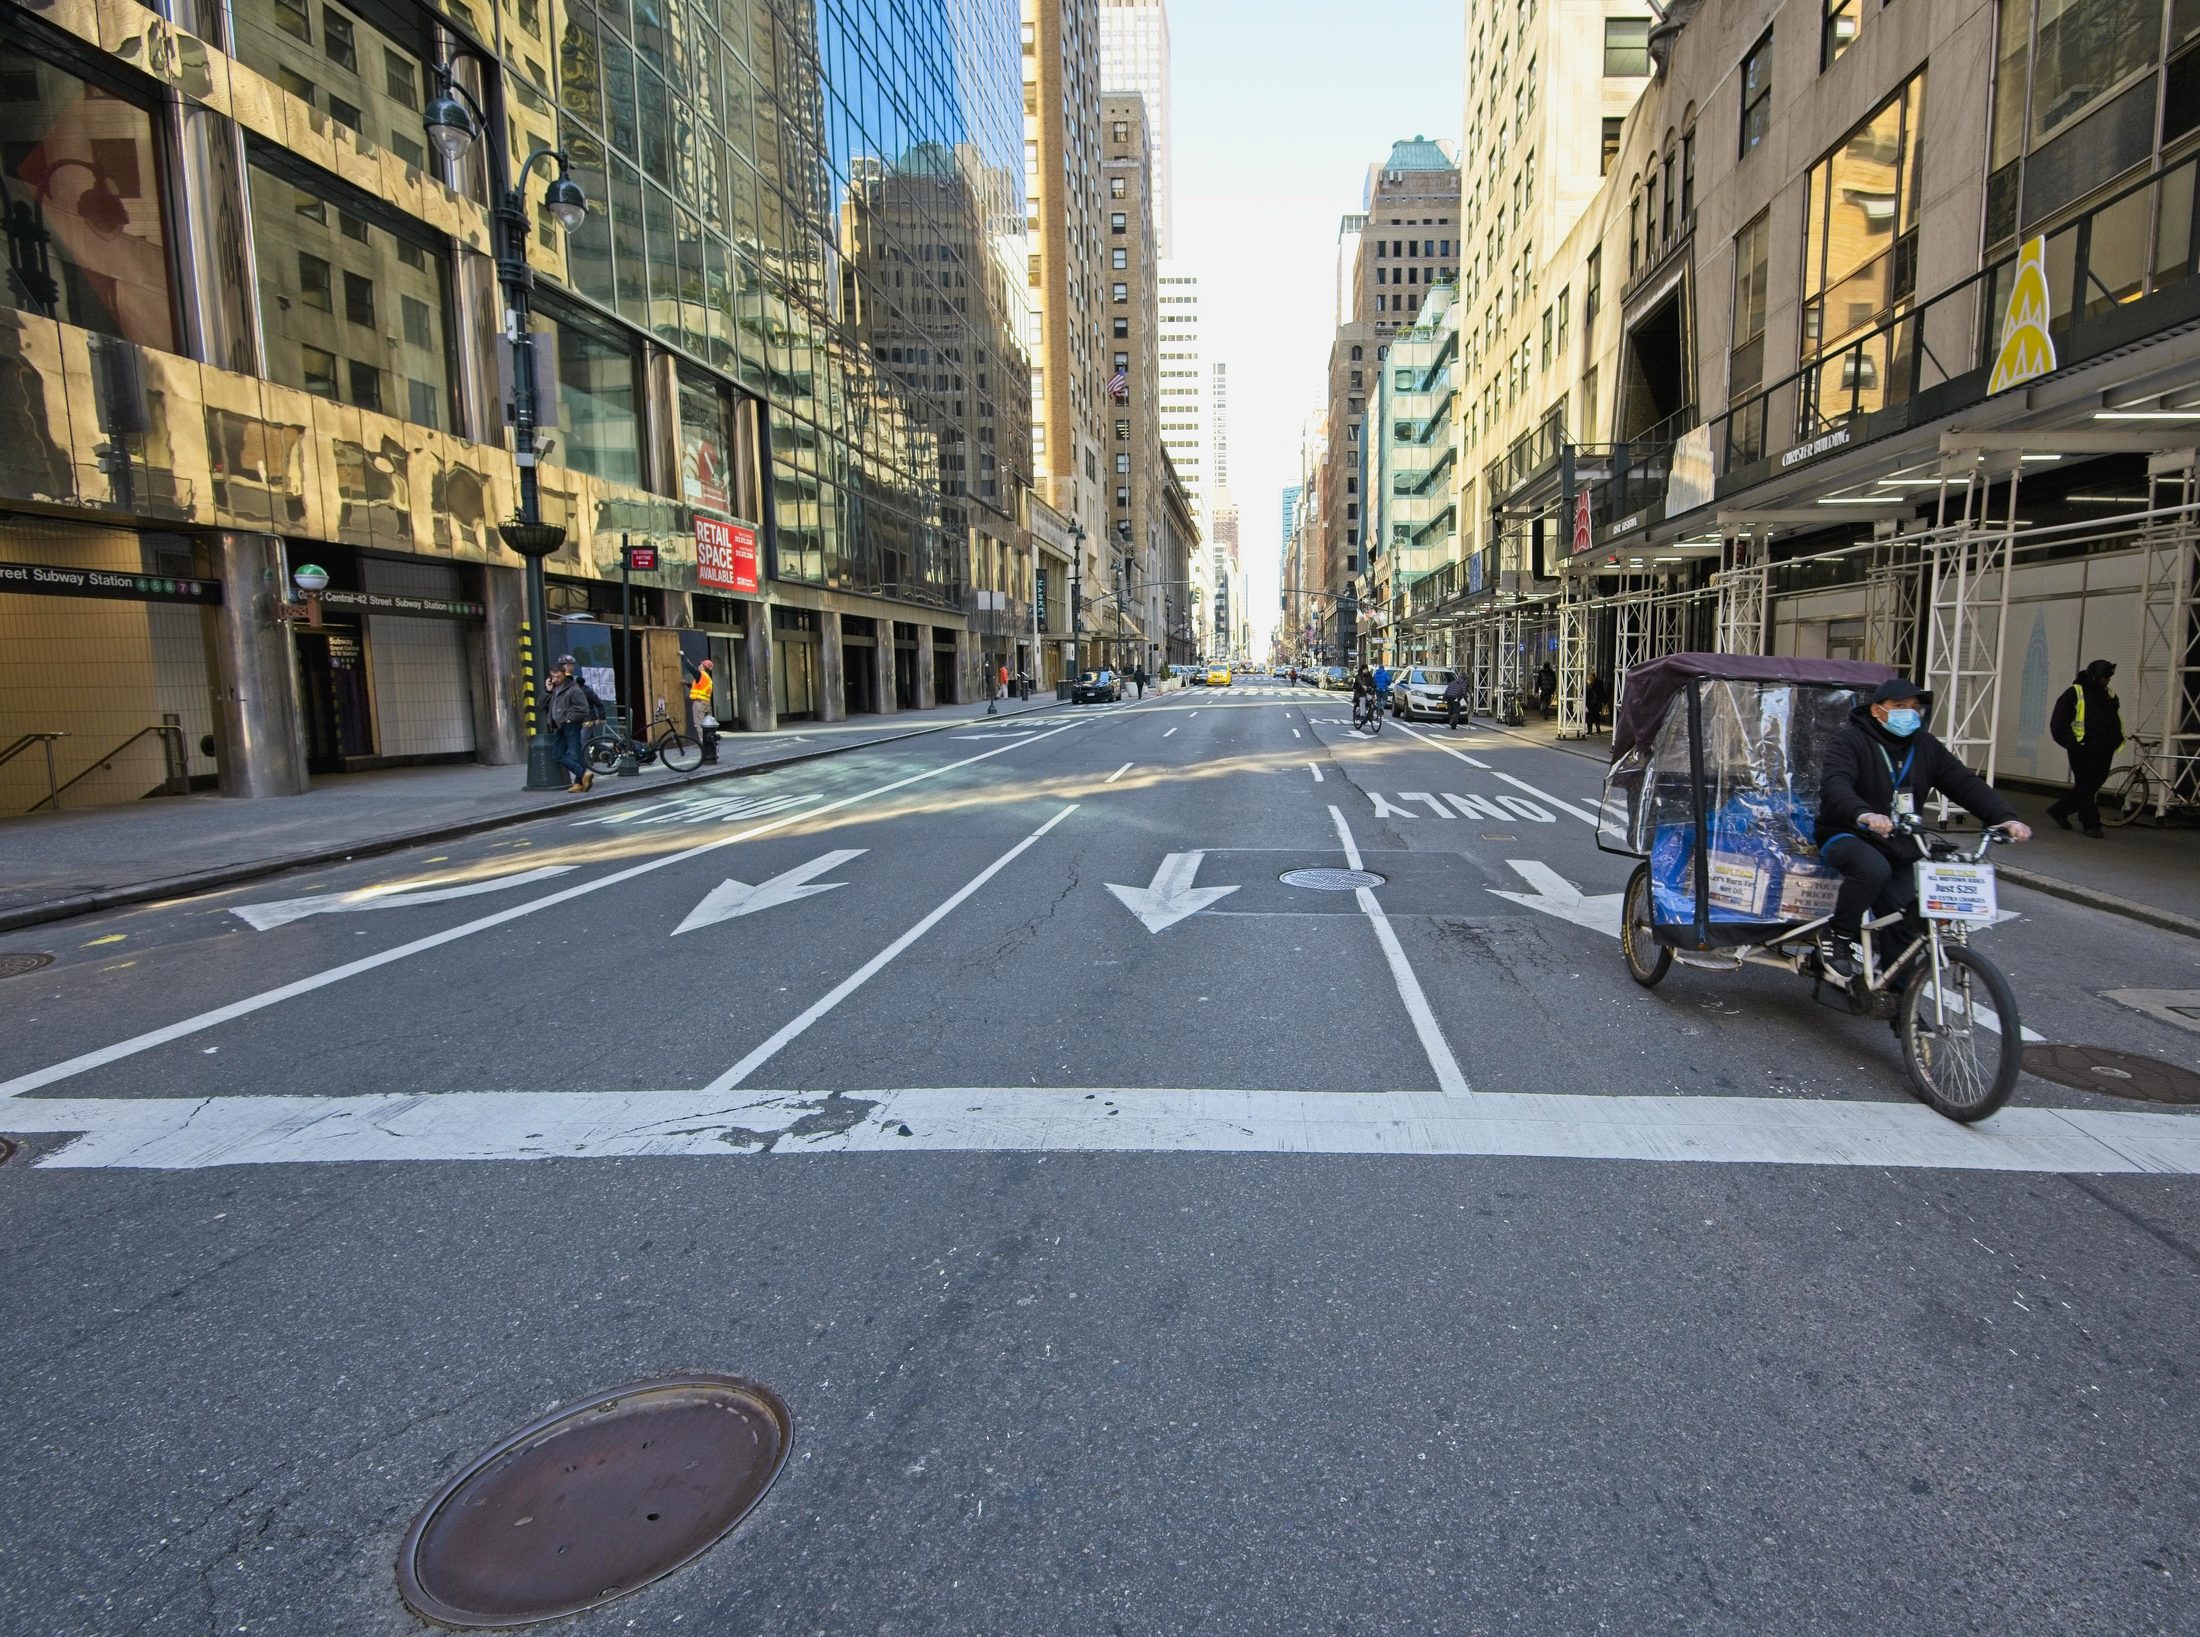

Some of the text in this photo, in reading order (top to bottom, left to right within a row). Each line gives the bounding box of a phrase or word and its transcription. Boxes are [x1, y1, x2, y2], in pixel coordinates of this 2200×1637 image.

[1813, 428, 1850, 455] BUILDING
[696, 520, 732, 548] RETAIL
[698, 542, 733, 570] SPACE
[0, 568, 28, 580] reet
[33, 568, 85, 586] Subway
[89, 573, 133, 588] Station
[699, 566, 734, 584] AVAILABLE
[369, 595, 392, 606] Street
[395, 597, 422, 610] Subway
[423, 600, 447, 610] Station
[1366, 792, 1557, 823] ONLY
[1935, 884, 1954, 893] Just
